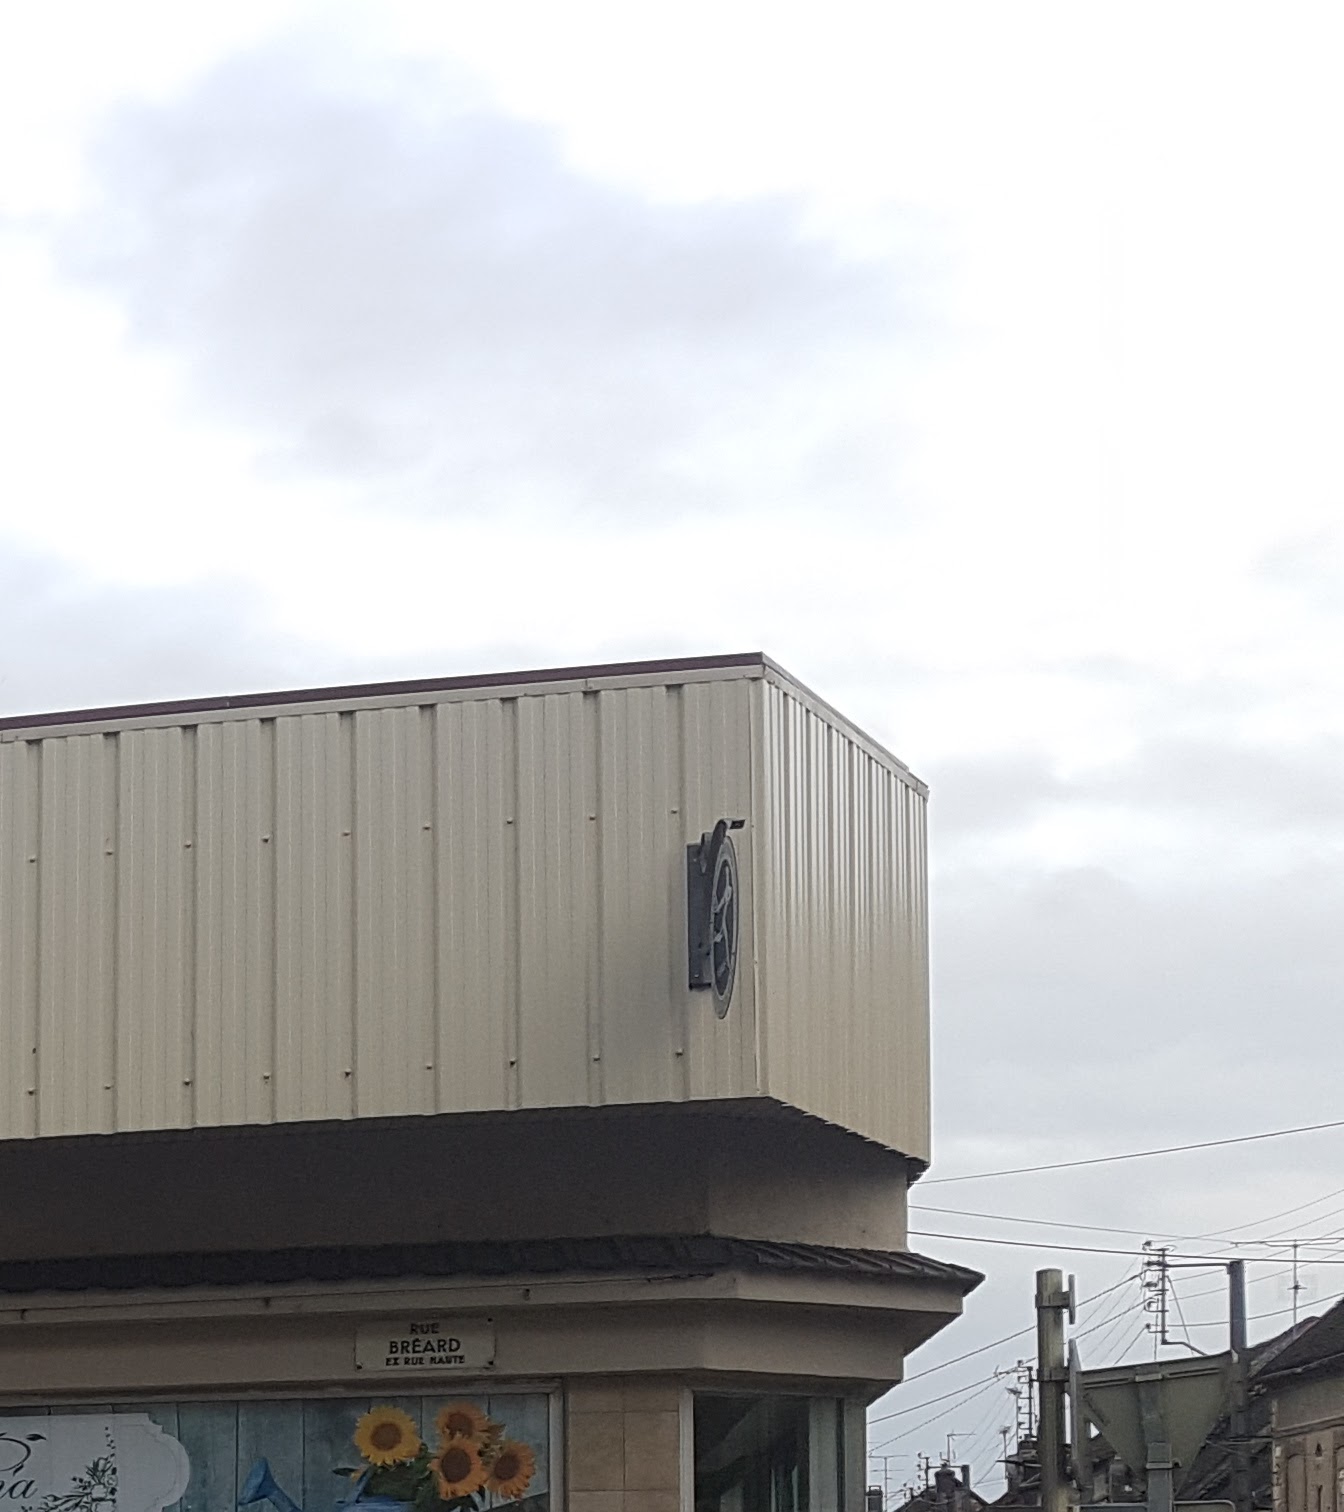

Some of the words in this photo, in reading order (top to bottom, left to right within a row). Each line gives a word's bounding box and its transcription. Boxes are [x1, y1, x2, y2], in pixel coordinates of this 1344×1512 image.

[409, 1322, 440, 1334] RUE
[389, 1338, 461, 1355] BRÉARD
[385, 1357, 400, 1366] EX
[404, 1356, 425, 1366] RUE
[430, 1355, 466, 1364] HAUTE
